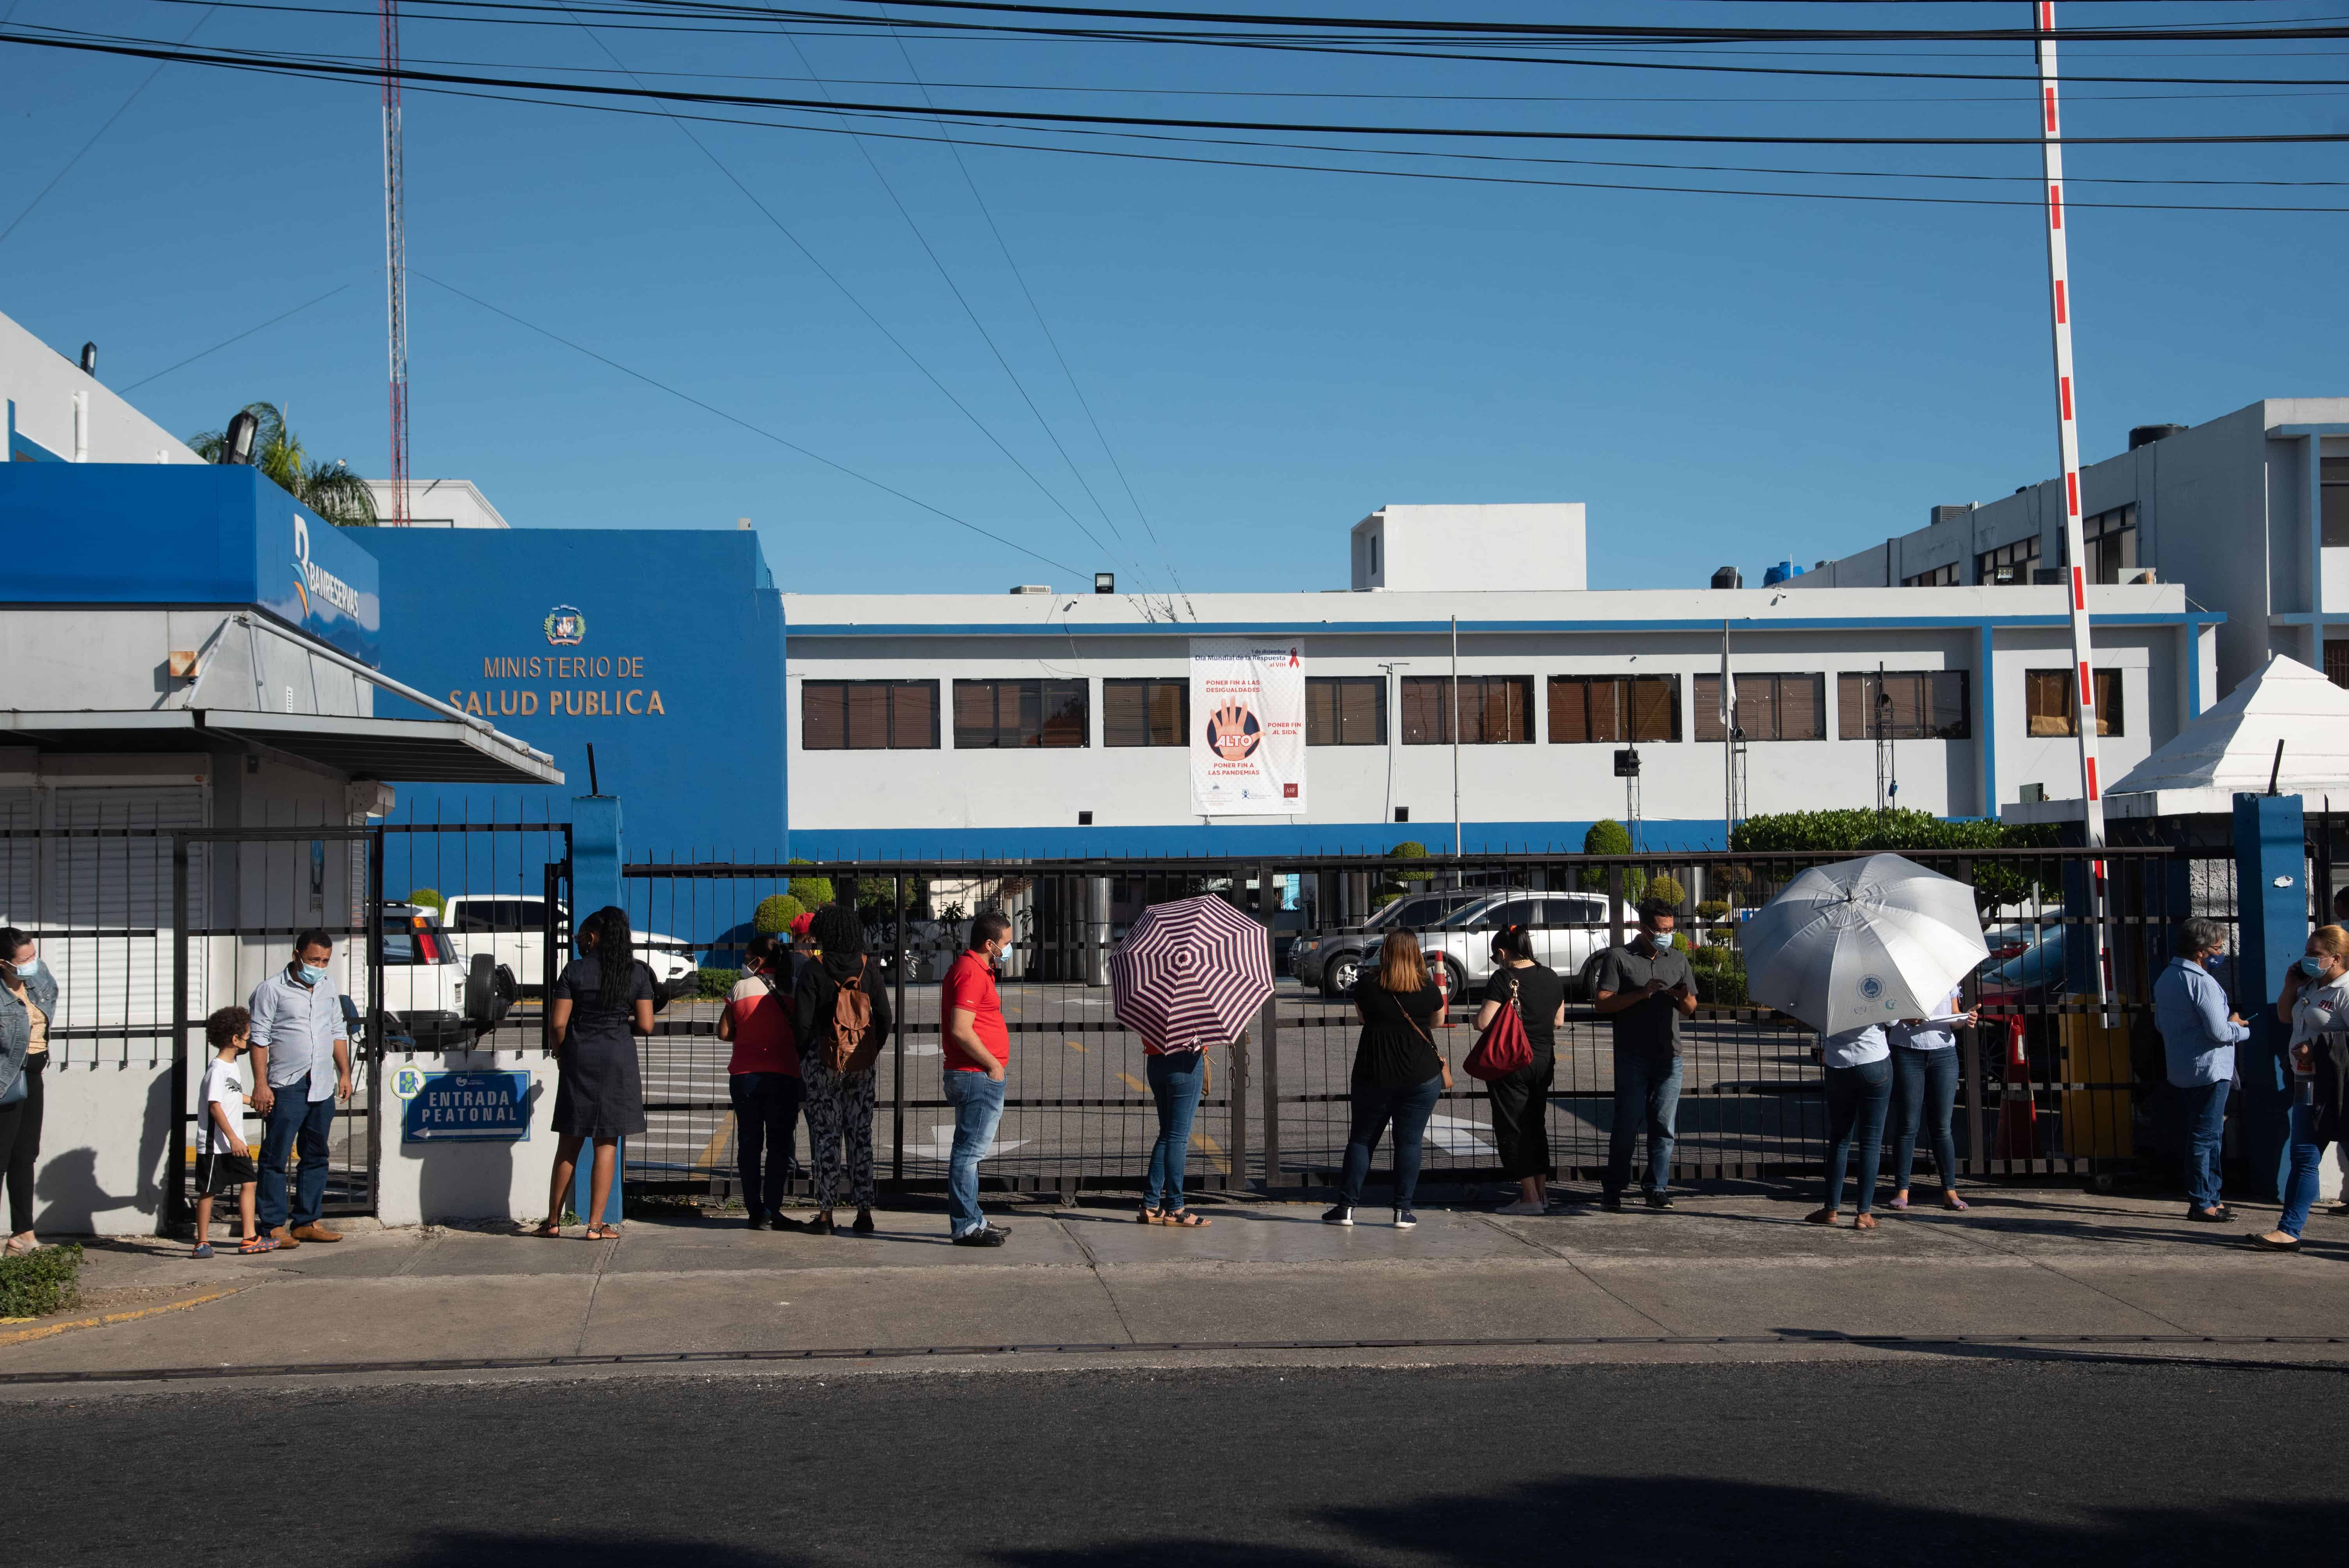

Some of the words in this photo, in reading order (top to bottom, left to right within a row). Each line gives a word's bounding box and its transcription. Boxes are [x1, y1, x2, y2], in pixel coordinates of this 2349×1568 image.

[309, 561, 359, 618] BANRESERVAS
[484, 656, 610, 678] MINISTERIO
[617, 657, 643, 678] DE
[449, 690, 538, 716] SALUD
[550, 690, 665, 716] PUBLICA
[1214, 735, 1253, 747] ALTO
[2318, 1000, 2333, 1010] 911
[429, 1091, 509, 1107] ENTRADA
[422, 1107, 517, 1122] PEATONAL
